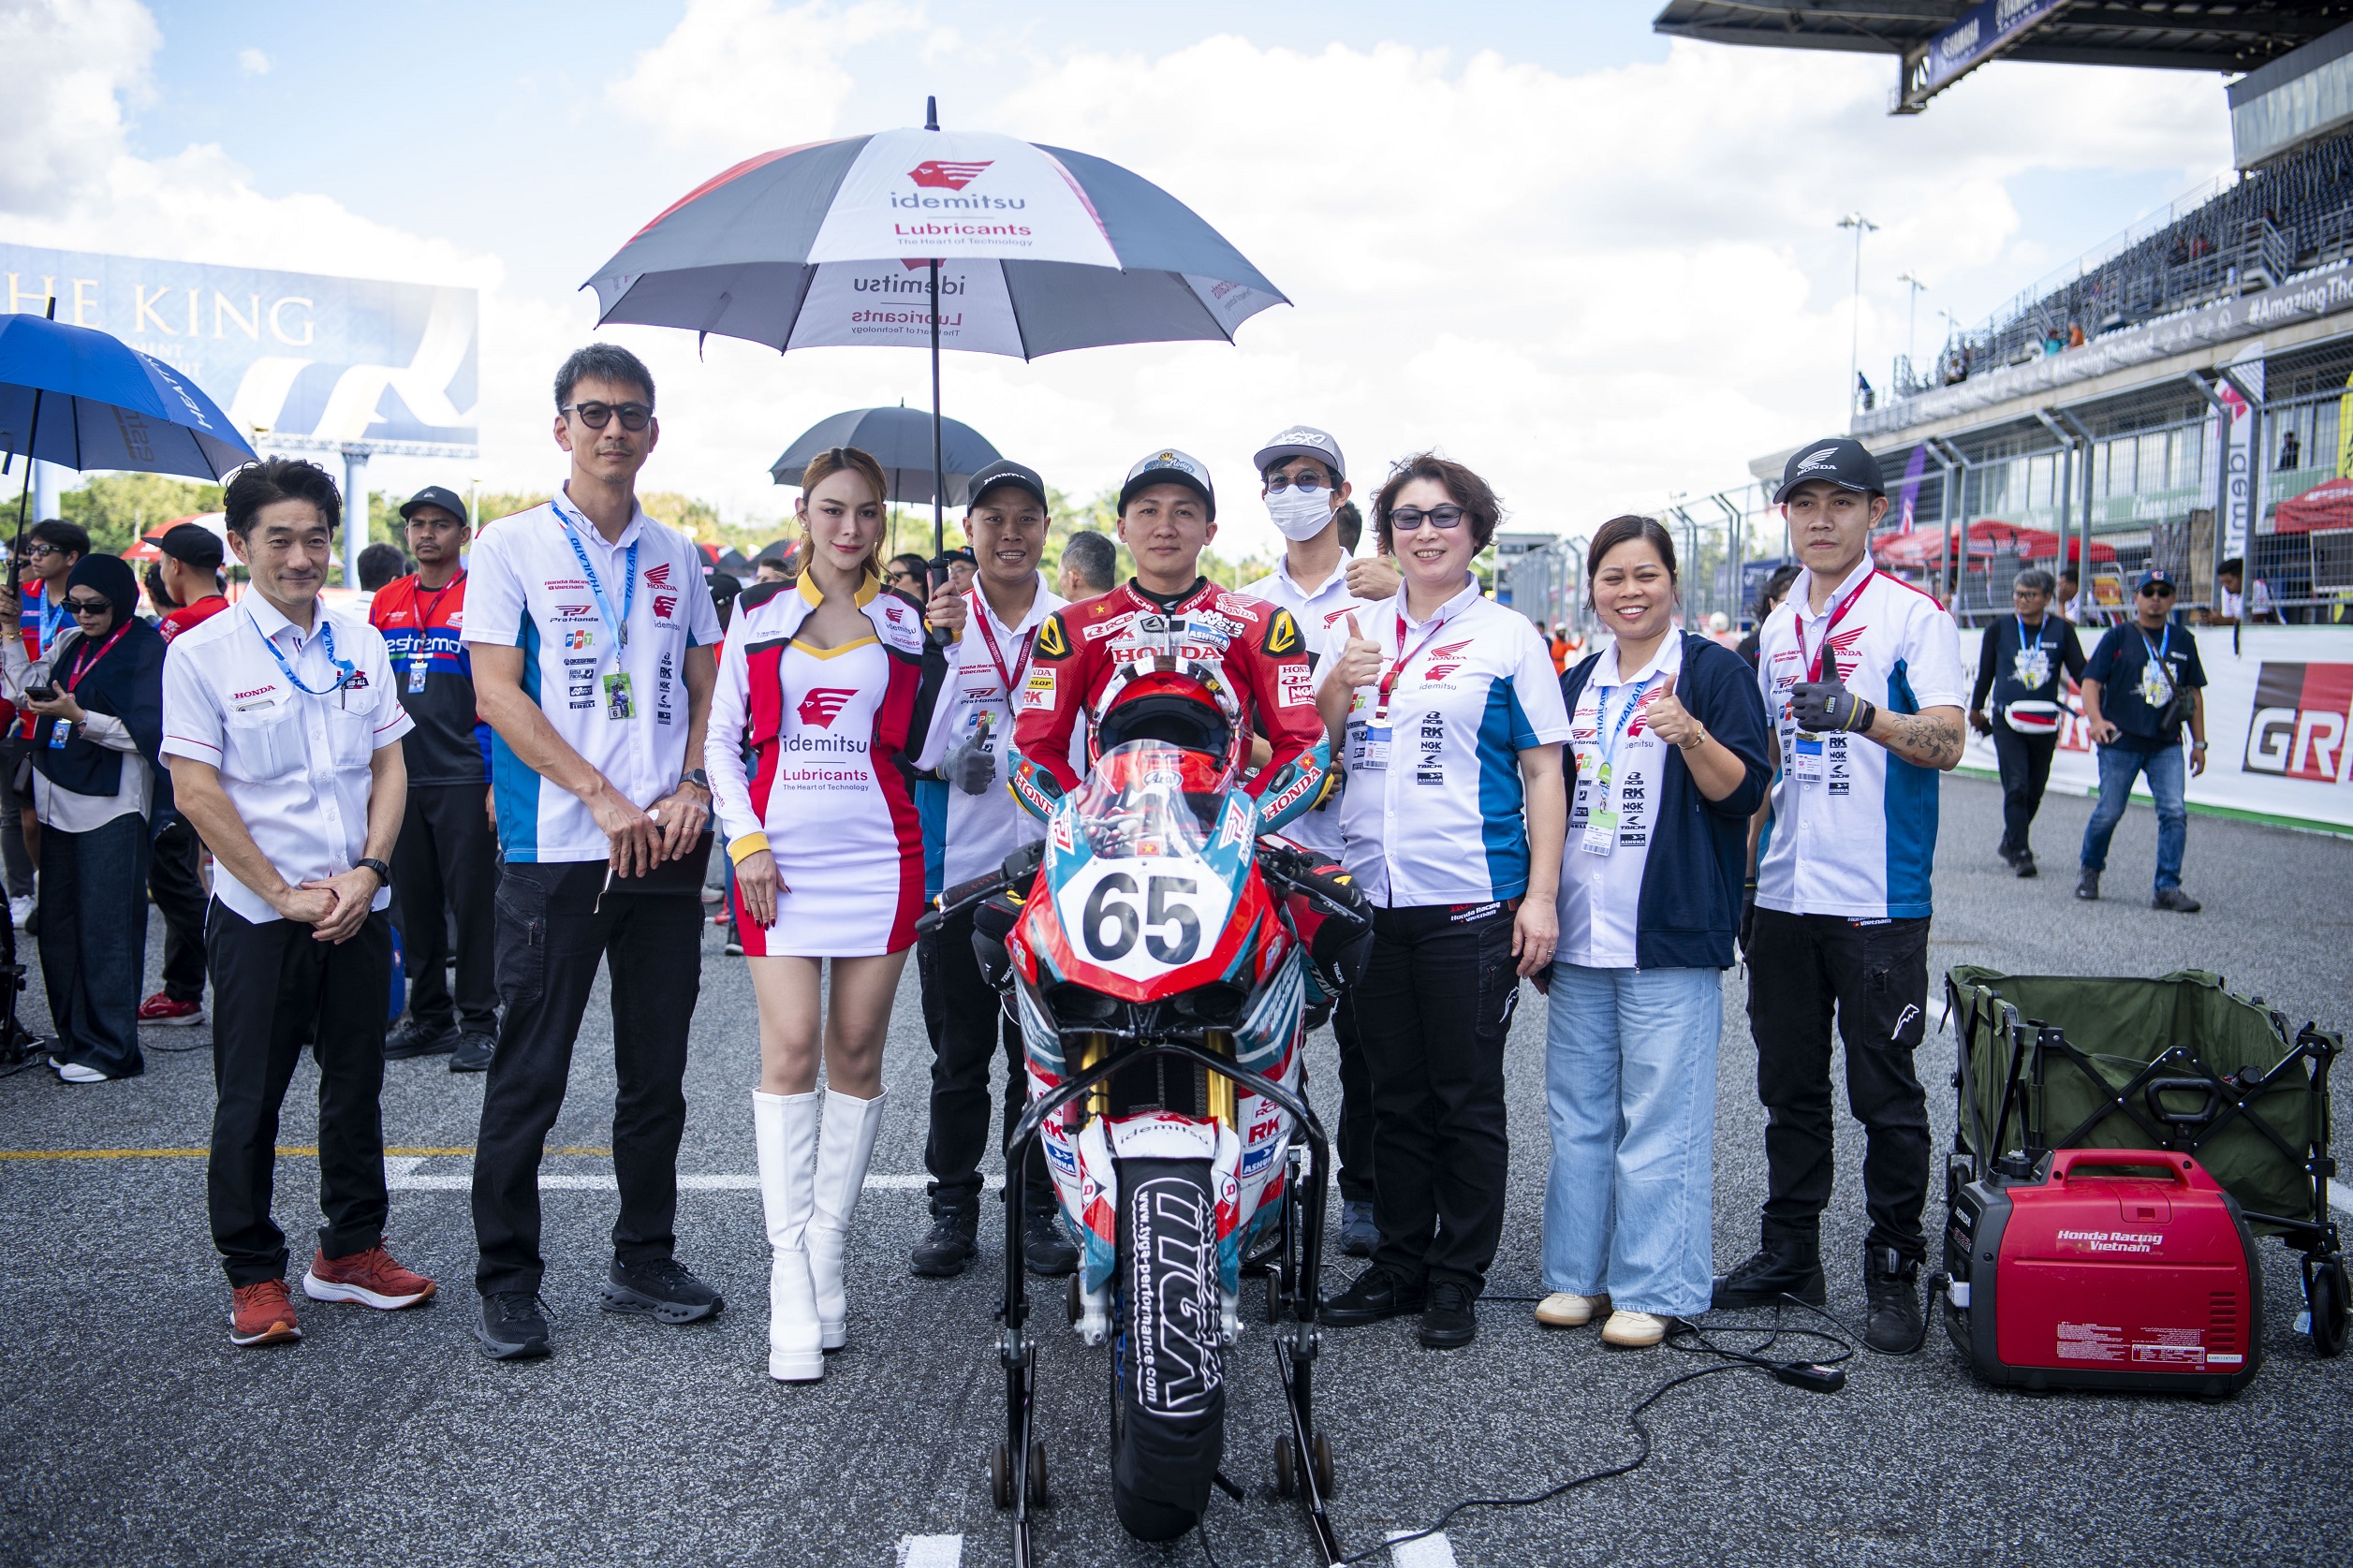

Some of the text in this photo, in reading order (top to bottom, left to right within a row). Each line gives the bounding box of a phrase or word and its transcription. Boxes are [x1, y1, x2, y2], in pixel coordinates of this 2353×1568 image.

[890, 192, 1025, 210] idemitsu
[894, 223, 1032, 236] Lubricants
[969, 238, 1033, 247] Technology
[135, 283, 314, 347] KING
[1797, 464, 1837, 476] HONDA
[570, 537, 602, 595] THAILAND
[646, 582, 678, 592] HONDA
[1125, 584, 1154, 611] TAICHI
[1183, 583, 1212, 611] TAICHI
[1217, 604, 1257, 620] HONDA
[885, 622, 917, 635] idemitsu
[1106, 614, 1135, 631] RCB
[566, 630, 593, 650] FPT
[1188, 630, 1228, 648] ASHUKA
[660, 667, 672, 678] RK
[234, 684, 276, 699] HONDA
[1419, 681, 1457, 691] idemitsu
[1023, 691, 1044, 703] RK
[969, 711, 996, 727] FPT
[1421, 726, 1444, 737] RK
[783, 734, 867, 754] idemitsu
[1421, 741, 1442, 750] NGK
[1830, 738, 1847, 747] RK
[1830, 751, 1846, 759] NGK
[783, 769, 868, 781] Lubricants
[827, 784, 869, 792] Technology
[1265, 767, 1323, 821] HONDA
[1623, 788, 1644, 798] RK
[1623, 802, 1643, 811] NGK
[1082, 872, 1201, 965] 65
[1450, 910, 1475, 921] Honda
[1476, 901, 1501, 914] Racing
[1465, 909, 1496, 922] Vietnam
[1860, 918, 1891, 927] Vietnam
[1332, 961, 1346, 984] TAICHI
[1121, 1125, 1209, 1145] idemitsu
[1248, 1113, 1281, 1144] RK
[1050, 1154, 1075, 1172] HUKA
[1083, 1184, 1094, 1195] D
[1226, 1183, 1235, 1195] D
[1954, 1206, 1972, 1227] HONDA
[2057, 1230, 2164, 1245] Honda Racing
[2090, 1240, 2151, 1253] Vietnam
[1137, 1190, 1159, 1403] www.tyga-performance.com
